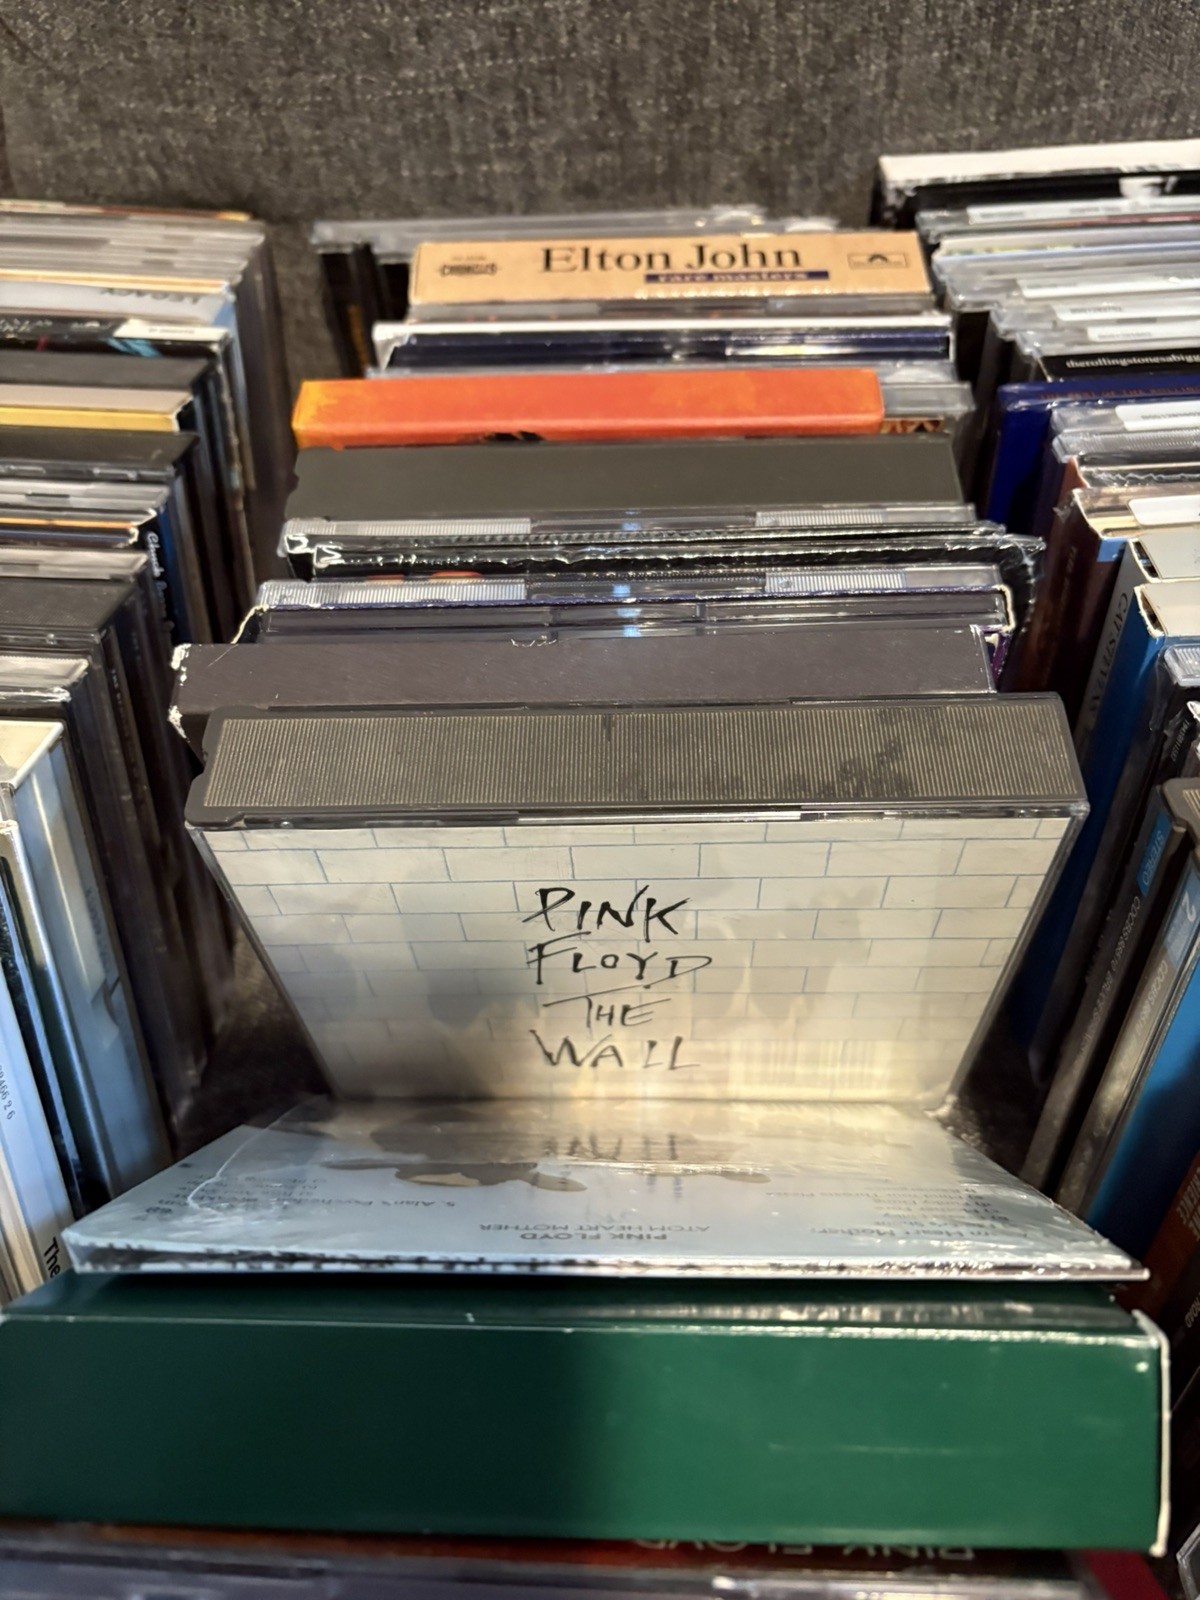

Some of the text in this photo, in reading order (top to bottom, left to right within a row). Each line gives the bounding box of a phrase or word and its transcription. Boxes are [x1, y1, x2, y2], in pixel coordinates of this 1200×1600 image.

[541, 242, 806, 273] Elton John
[657, 270, 809, 283] rare masters
[1114, 592, 1128, 632] CAT
[1142, 830, 1165, 886] STEREO
[522, 884, 693, 943] PINK
[1181, 891, 1197, 923] 2
[526, 931, 713, 989] FLOYD
[542, 984, 672, 1028] THE
[529, 1029, 702, 1071] WALL
[479, 1223, 711, 1233] ATOM HEART MOTHER
[519, 1232, 668, 1241] PINK FLOYD
[44, 1236, 61, 1278] The
